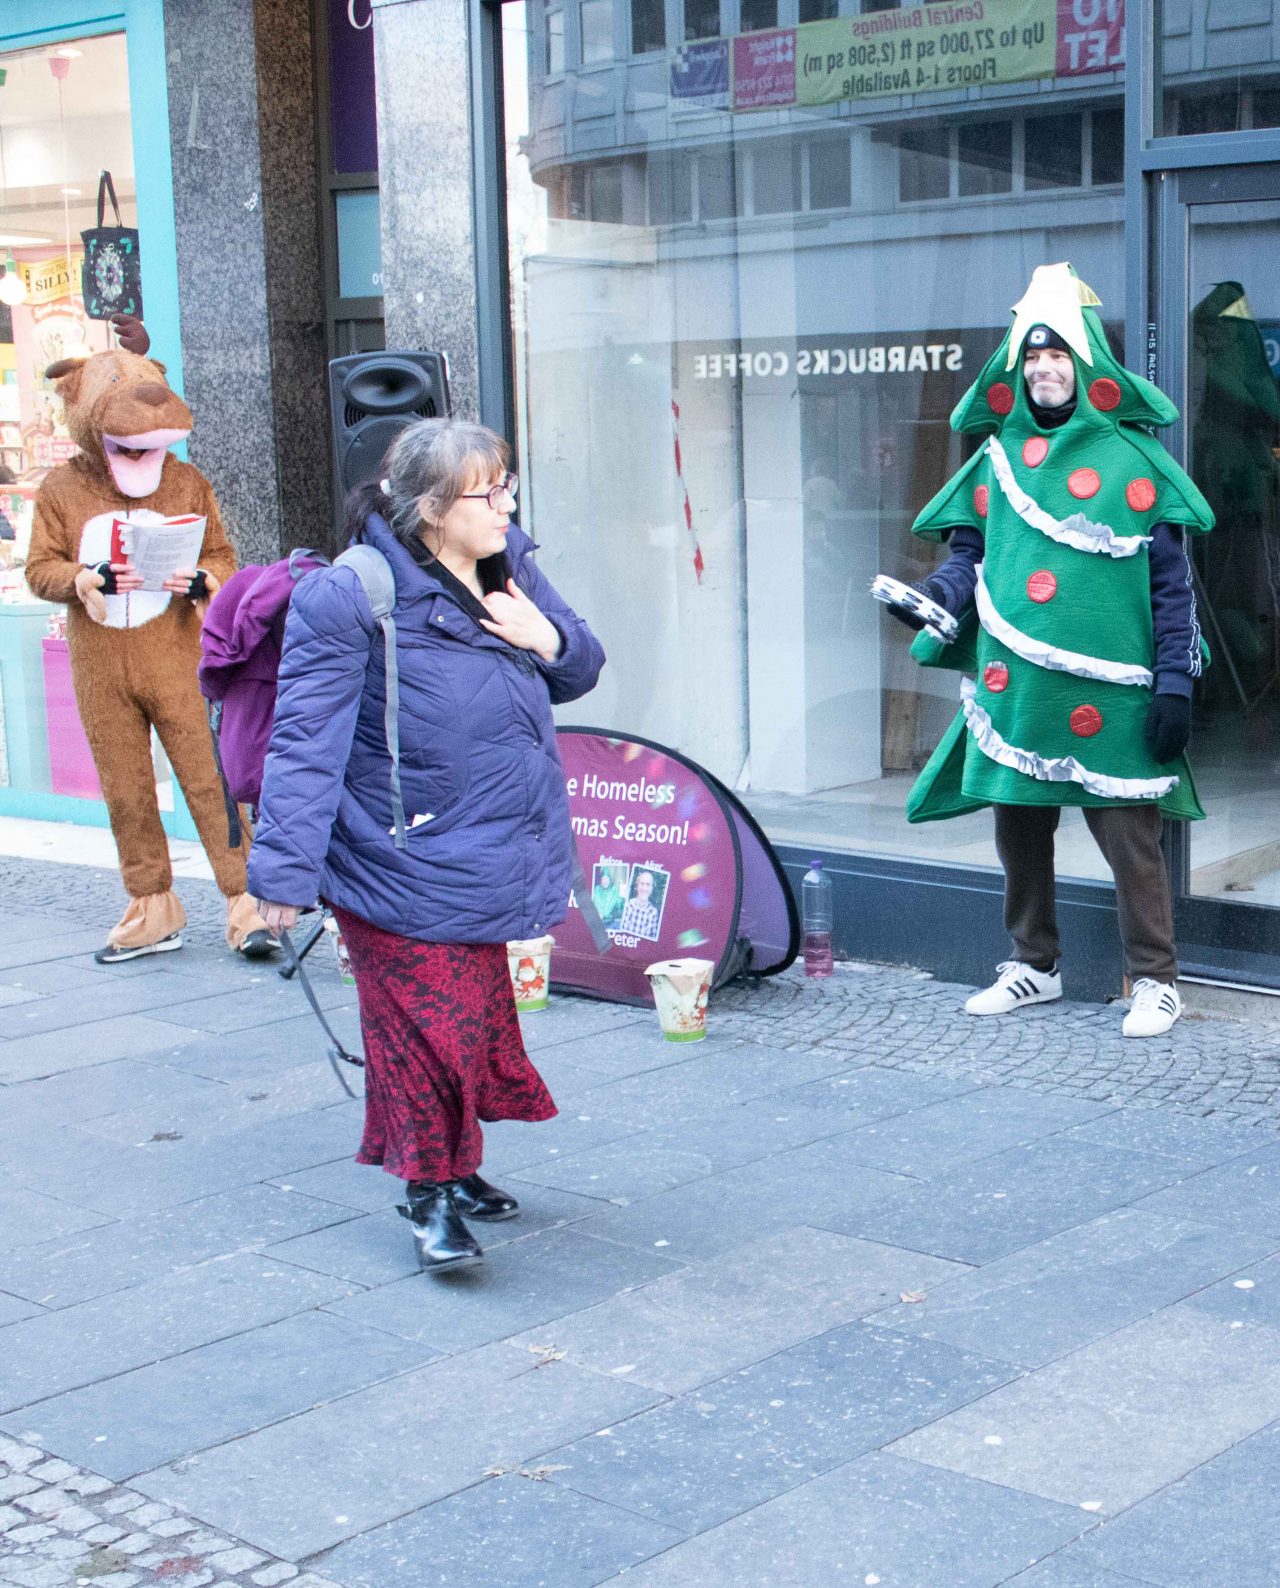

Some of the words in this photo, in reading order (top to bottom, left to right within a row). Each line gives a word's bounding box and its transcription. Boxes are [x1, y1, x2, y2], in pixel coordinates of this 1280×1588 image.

[35, 269, 77, 292] SILLY!
[582, 773, 676, 804] Homeless
[612, 815, 690, 846] Season!
[607, 930, 641, 949] Peter
